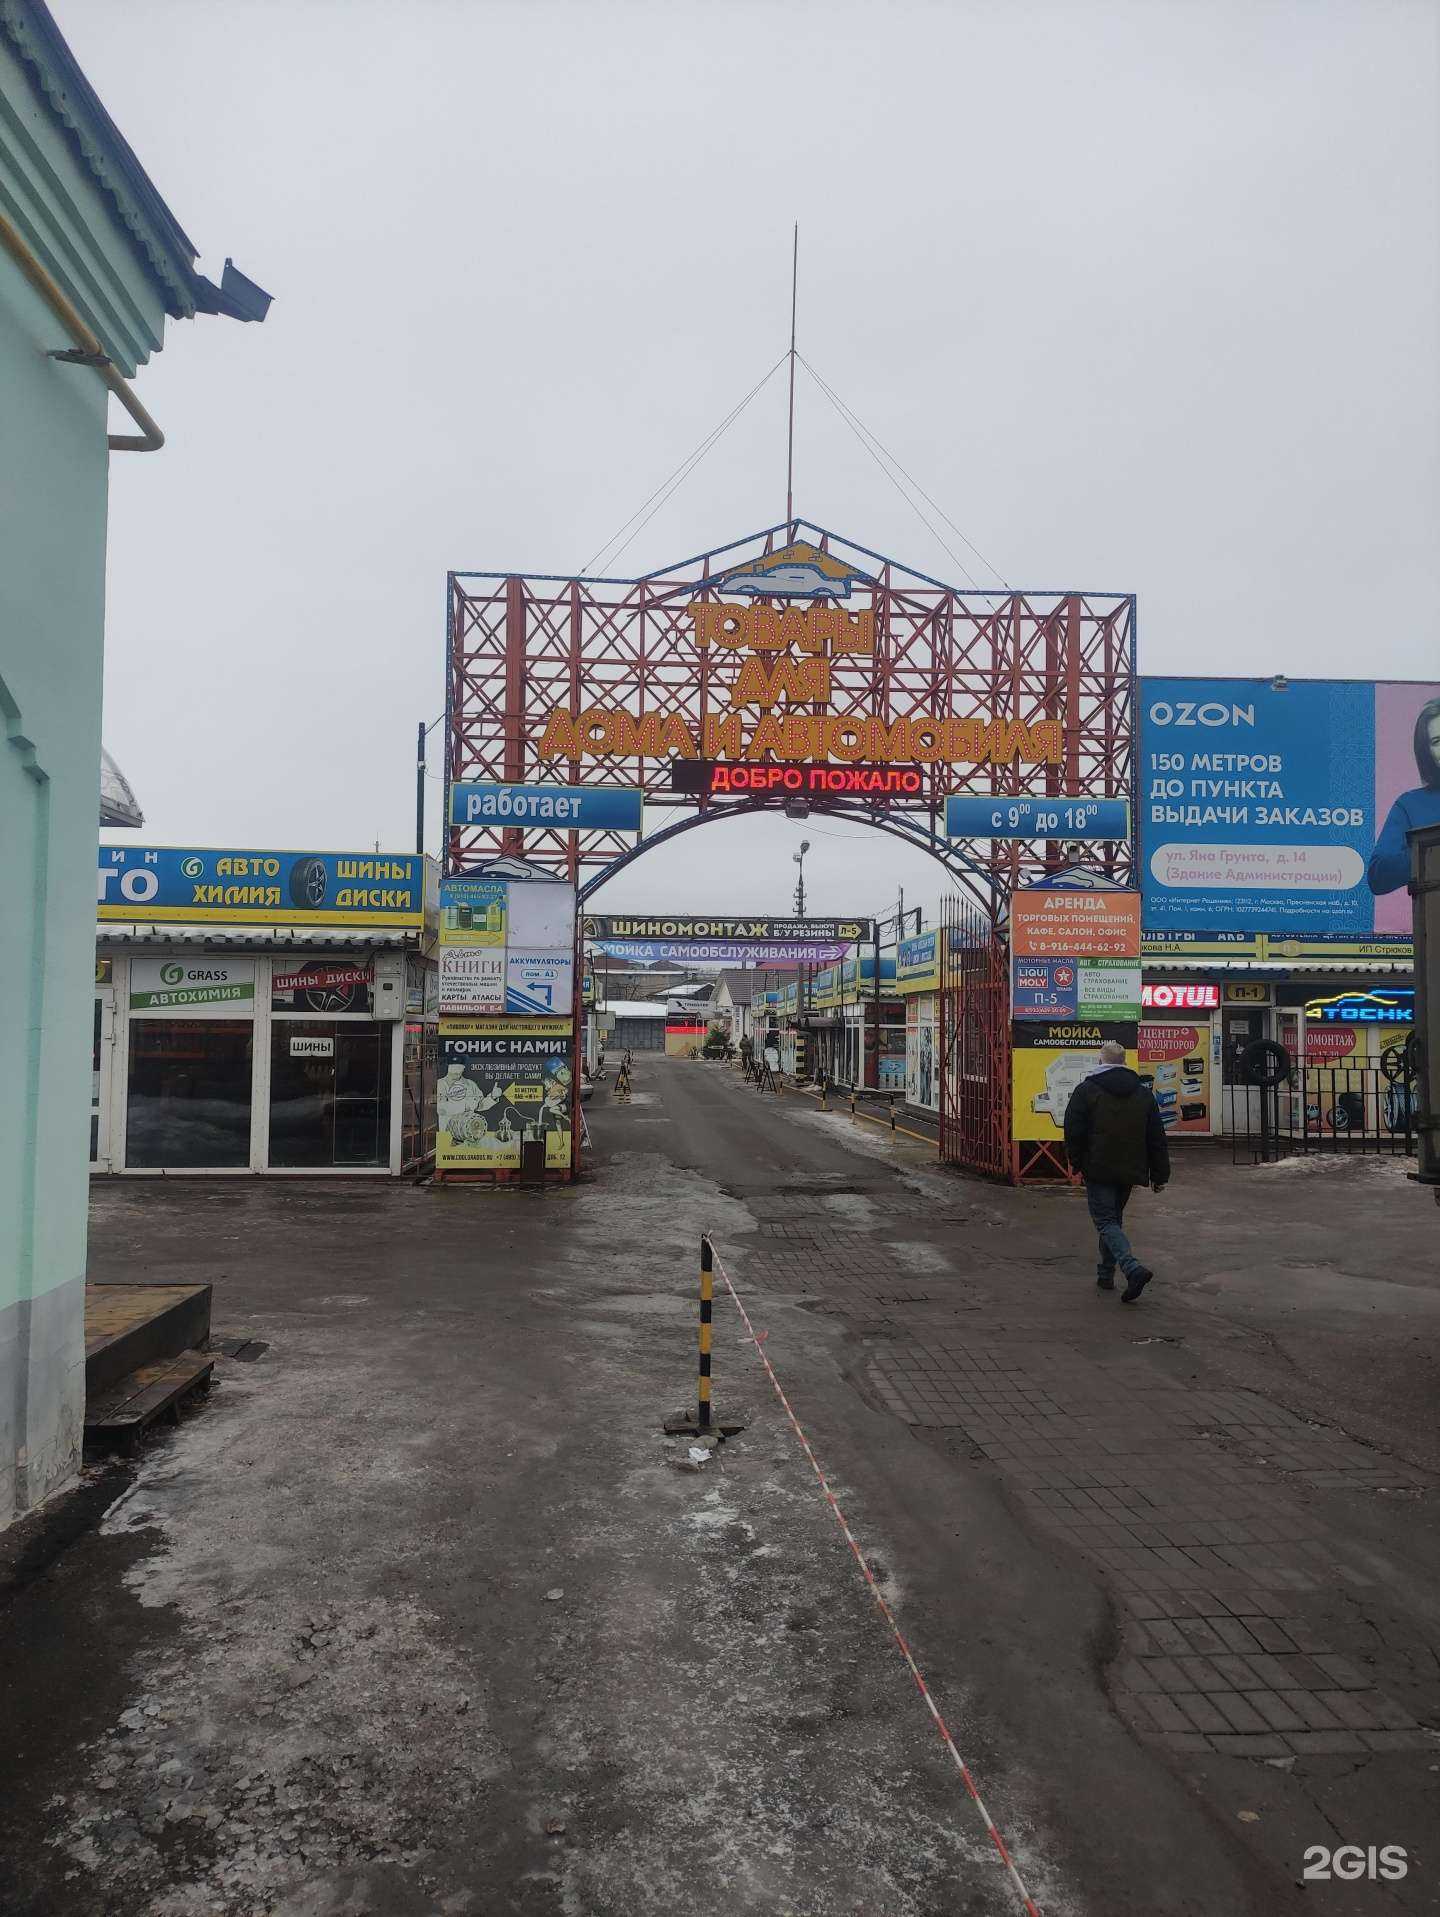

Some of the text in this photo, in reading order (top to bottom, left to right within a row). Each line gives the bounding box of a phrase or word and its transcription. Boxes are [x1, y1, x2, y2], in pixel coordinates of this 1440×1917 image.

[687, 602, 876, 654] ТОВАРЫ
[732, 656, 832, 707] ДЛЯ
[1150, 701, 1255, 727] OZON
[538, 708, 1064, 763] ДОМА И АВТОМОБИЛЯ
[1151, 754, 1282, 772] 150 МЕТРОВ
[711, 766, 922, 792] ДОБРО ПОЖАЛО
[1150, 779, 1284, 799] ДО ПУНКТА
[466, 793, 582, 819] работает
[991, 811, 1003, 828] с
[1035, 811, 1058, 833] до
[1151, 805, 1364, 827] ВЫДАЧИ ЗАКАЗОВ
[1166, 851, 1186, 862] ул.
[1277, 852, 1289, 864] д.
[1293, 851, 1306, 863] 14
[216, 857, 280, 877] АВТО
[336, 860, 412, 880] ШИНЫ
[1166, 866, 1343, 884] (Здание Администрации)
[192, 884, 281, 905] ХИМИЯ
[335, 888, 411, 908] ДИСКИ
[1043, 897, 1107, 910] АРЕНДА
[1017, 913, 1136, 924] ТОРГОВЫХ ПОМЕЩЕНИЙ,
[612, 920, 769, 937] ШИНОМОНТАЖ
[773, 929, 835, 937] Б/У РЕЗИНЫ
[1097, 928, 1128, 937] ОФИС
[603, 943, 818, 960] МОЙКА САМООБСЛУЖИВАНИЯ
[1039, 941, 1126, 952] 8-916-444-62-92
[1165, 943, 1183, 951] Н.А.
[1359, 945, 1373, 953] ИП
[442, 960, 502, 974] КНИГИ
[509, 957, 571, 965] АККУМУЛЯТОРЫ
[187, 969, 228, 982] GRASS
[276, 970, 371, 990] ШИНЫ ДИСКИ
[1019, 969, 1047, 977] LIQUI
[1019, 978, 1047, 987] MOLY
[149, 986, 241, 1006] АВТОХИМИЯ
[1034, 992, 1058, 1004] П-5
[1142, 986, 1219, 1007] MOTUL
[1234, 986, 1258, 998] П-1
[440, 1004, 486, 1012] ПАВИЛЬОН
[1048, 1023, 1102, 1039] МОЙКА
[1143, 1027, 1180, 1039] ЦЕНТР
[292, 1041, 332, 1053] ШИНЫ
[444, 1040, 567, 1053] ГОНИ С НАМИ!
[470, 1062, 517, 1071] ЭКСКЛЮЗИВНЫЙ
[495, 1072, 521, 1080] ДЕЛАЕТЕ
